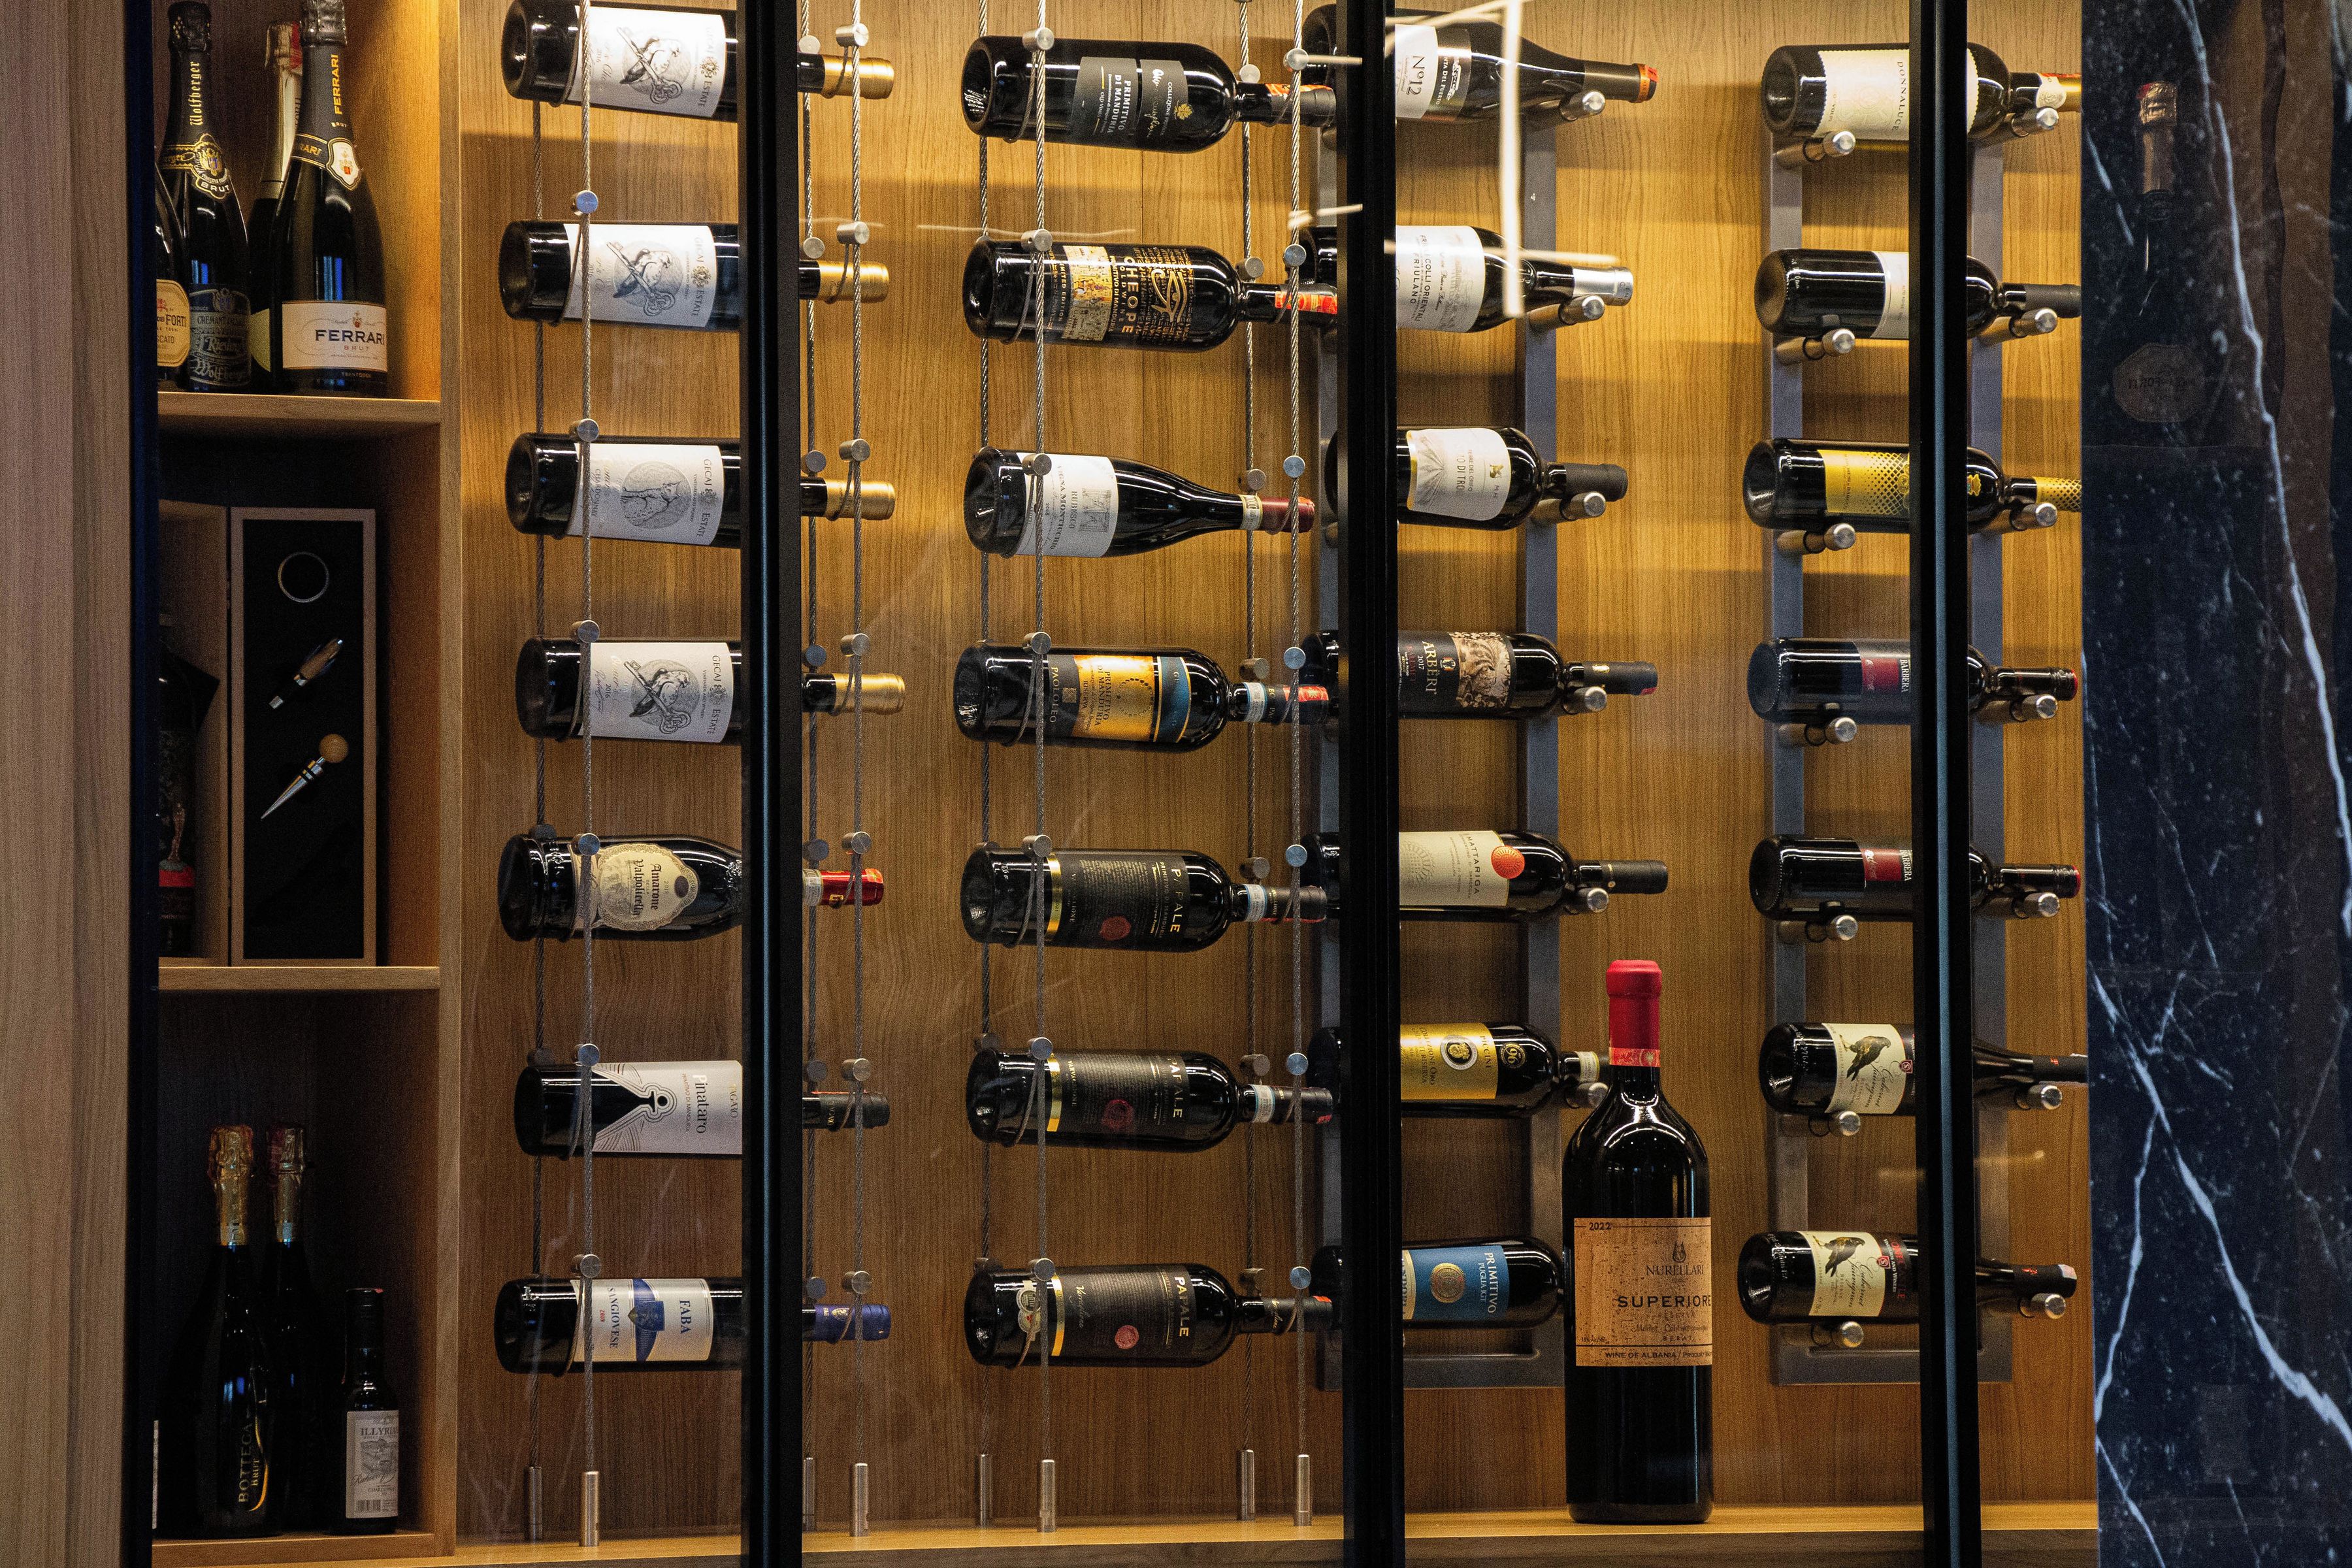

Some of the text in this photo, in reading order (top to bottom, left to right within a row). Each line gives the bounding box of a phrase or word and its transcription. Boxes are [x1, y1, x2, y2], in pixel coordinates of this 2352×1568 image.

[188, 61, 203, 125] Wolfberger
[331, 54, 342, 115] FERRARI
[697, 80, 713, 107] ESTATE
[1107, 74, 1122, 133] DI MANDURIA
[1119, 80, 1132, 131] PRIMITIVO
[1436, 84, 1446, 105] PUERTO
[1892, 61, 1907, 131] DONNALUCE
[201, 182, 230, 193] BRUT
[1109, 255, 1120, 287] PRIMITIVO
[1411, 253, 1420, 304] FRIULANO
[691, 289, 705, 318] ESTATE
[1058, 291, 1068, 321] EDITION
[1108, 297, 1119, 332] MANDURIA
[1121, 256, 1139, 333] CHEOPE
[1415, 285, 1431, 321] ORIENTALI
[165, 314, 187, 328] FORTI
[315, 329, 384, 346] FERRARI
[591, 468, 601, 517] CHARDONNAY
[696, 459, 713, 538] GECAJ ESTATE
[1069, 491, 1079, 529] RUBESCO
[1050, 494, 1067, 549] MONTICCHIO
[1422, 640, 1440, 691] ARBËRI
[1900, 659, 1910, 693] BARBERA
[706, 655, 721, 735] GECAJ ESTATE
[1094, 676, 1105, 727] MANDURIA
[1102, 671, 1113, 721] PRIMITIVO
[633, 859, 645, 915] Valpolicella
[651, 864, 662, 911] Amarone
[1159, 862, 1169, 894] PRIMITIVO
[1467, 836, 1481, 894] MATTARIGA
[1899, 849, 1913, 881] BARBERA
[1159, 906, 1169, 938] MANDURIA
[1480, 1036, 1492, 1068] PICCINI
[1506, 1048, 1518, 1064] 96
[693, 1075, 710, 1134] Pinataro
[1168, 1058, 1184, 1118] PAPALE
[1876, 1068, 1895, 1107] Cabernet
[1589, 1222, 1612, 1231] 2022
[1478, 1263, 1487, 1288] PUGLIA
[1484, 1252, 1499, 1313] PRIMITIVO
[1646, 1262, 1705, 1276] NURELLARI
[1846, 1260, 1860, 1307] Sauvignon
[1859, 1264, 1874, 1307] Cabernet
[608, 1288, 620, 1348] SANGIOVESE
[679, 1300, 692, 1334] FABA
[1175, 1276, 1190, 1337] PAPALE
[1618, 1295, 1711, 1308] SUPERIORE
[238, 1423, 252, 1503] BOTTEGA
